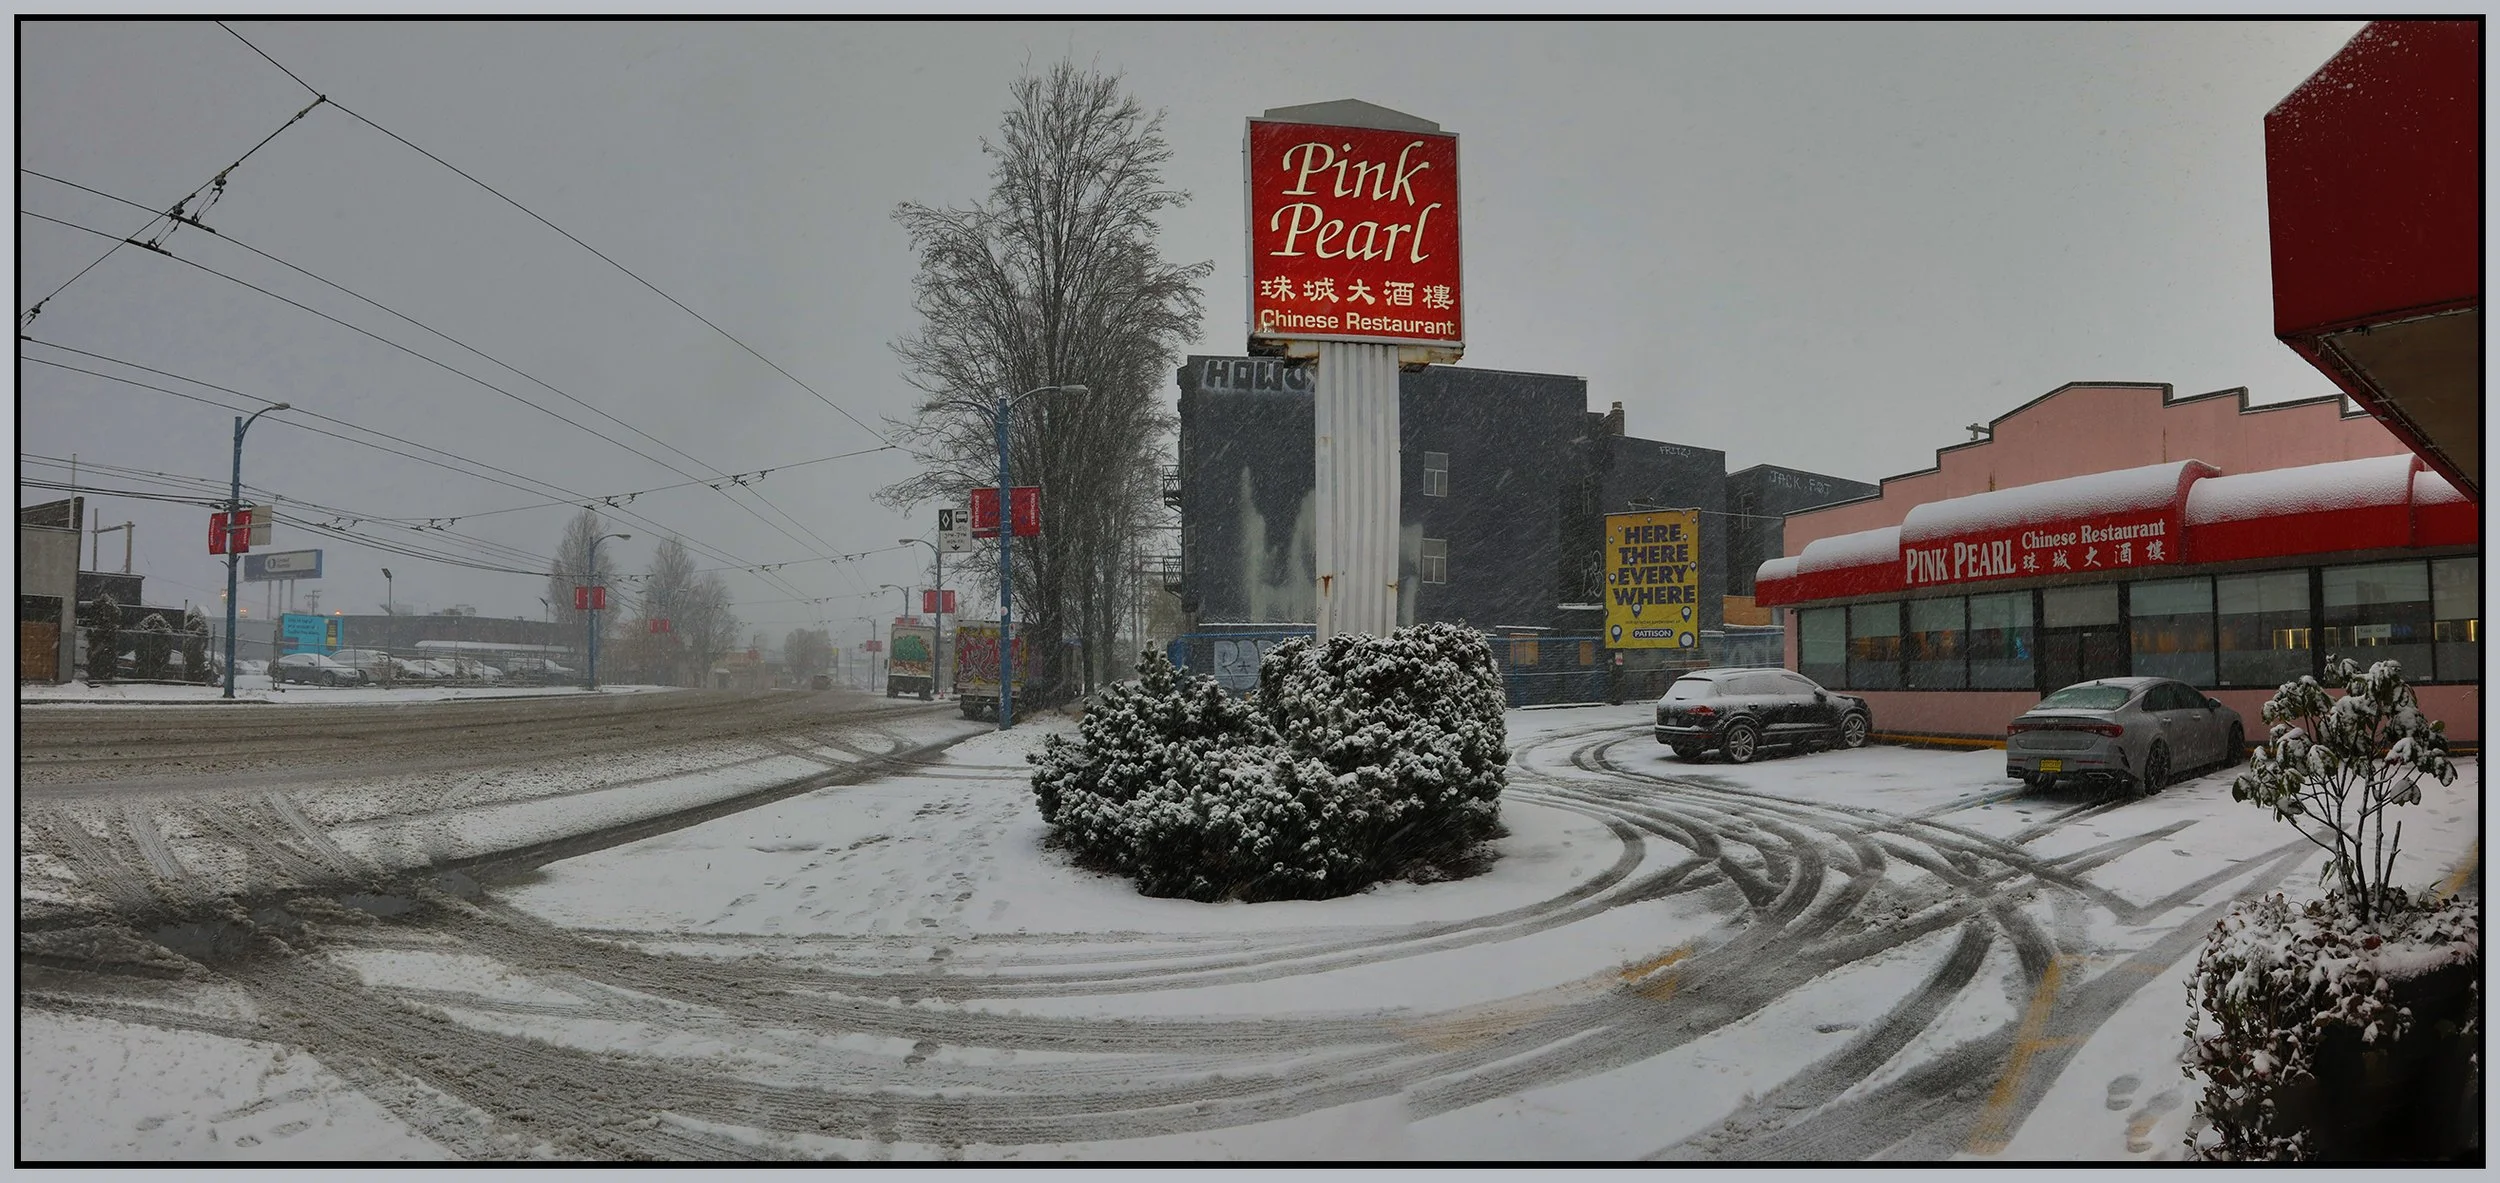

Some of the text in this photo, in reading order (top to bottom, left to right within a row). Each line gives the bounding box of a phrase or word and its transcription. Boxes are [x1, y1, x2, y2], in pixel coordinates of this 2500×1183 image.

[1282, 141, 1430, 206] Pink
[1270, 202, 1442, 264] Pearl
[1260, 276, 1455, 310] 珠城大酒樓
[1260, 309, 1456, 335] Chinese Restaurant
[2021, 518, 2166, 550] Chinese Restaurant
[1618, 544, 1689, 565] THERE
[1906, 539, 2016, 584] PINK PEARL
[2022, 539, 2166, 573] 珠城大酒樓
[1618, 565, 1689, 585] EVERY
[1612, 585, 1695, 606] WHERE
